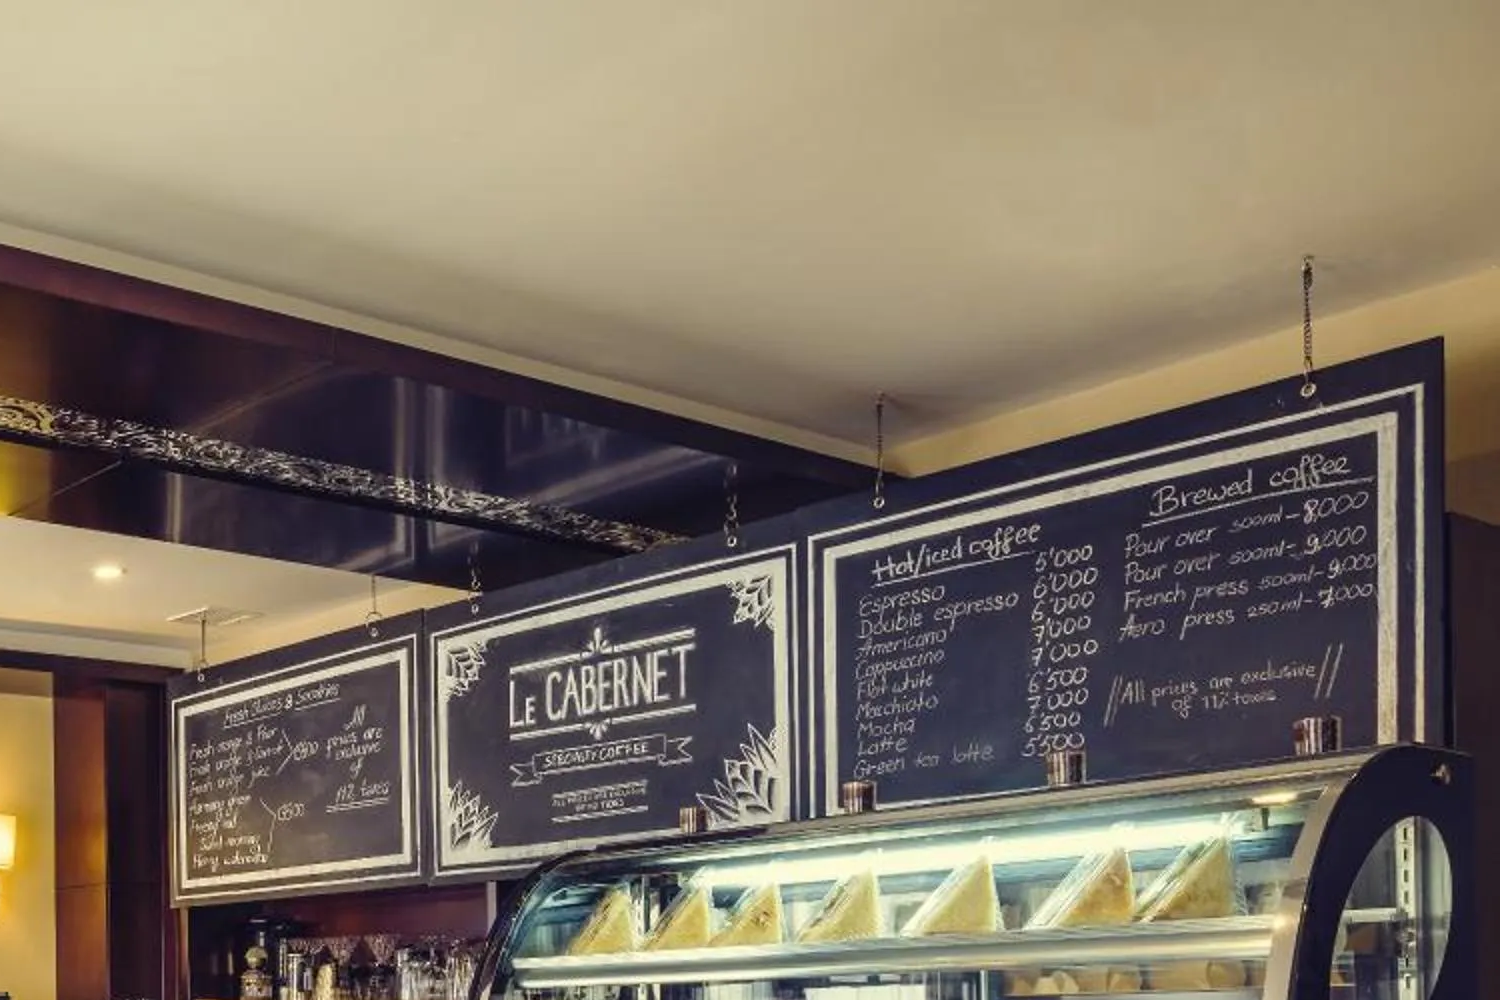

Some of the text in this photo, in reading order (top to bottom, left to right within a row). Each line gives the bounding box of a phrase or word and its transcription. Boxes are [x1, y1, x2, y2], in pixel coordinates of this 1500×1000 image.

[1150, 453, 1353, 517] Brewed coffee
[872, 524, 1041, 581] Hot/iced coffee
[1124, 533, 1171, 559] Pour
[1175, 527, 1217, 547] over
[1124, 561, 1167, 585] Pour
[1173, 551, 1221, 575] over
[859, 585, 945, 621] Espresso
[1124, 582, 1187, 612] French
[1190, 580, 1249, 611] press
[857, 607, 924, 639] Double
[933, 592, 1019, 632] espresso
[1180, 609, 1235, 641] press
[855, 629, 947, 660] Americano
[546, 643, 697, 722] CABERNET
[892, 669, 933, 693] white
[1209, 677, 1233, 690] are
[1241, 660, 1316, 685] exclusive
[857, 716, 915, 738] Mocha
[599, 741, 649, 761] COFFEE
[857, 736, 908, 757] Latte
[854, 757, 905, 780] Green
